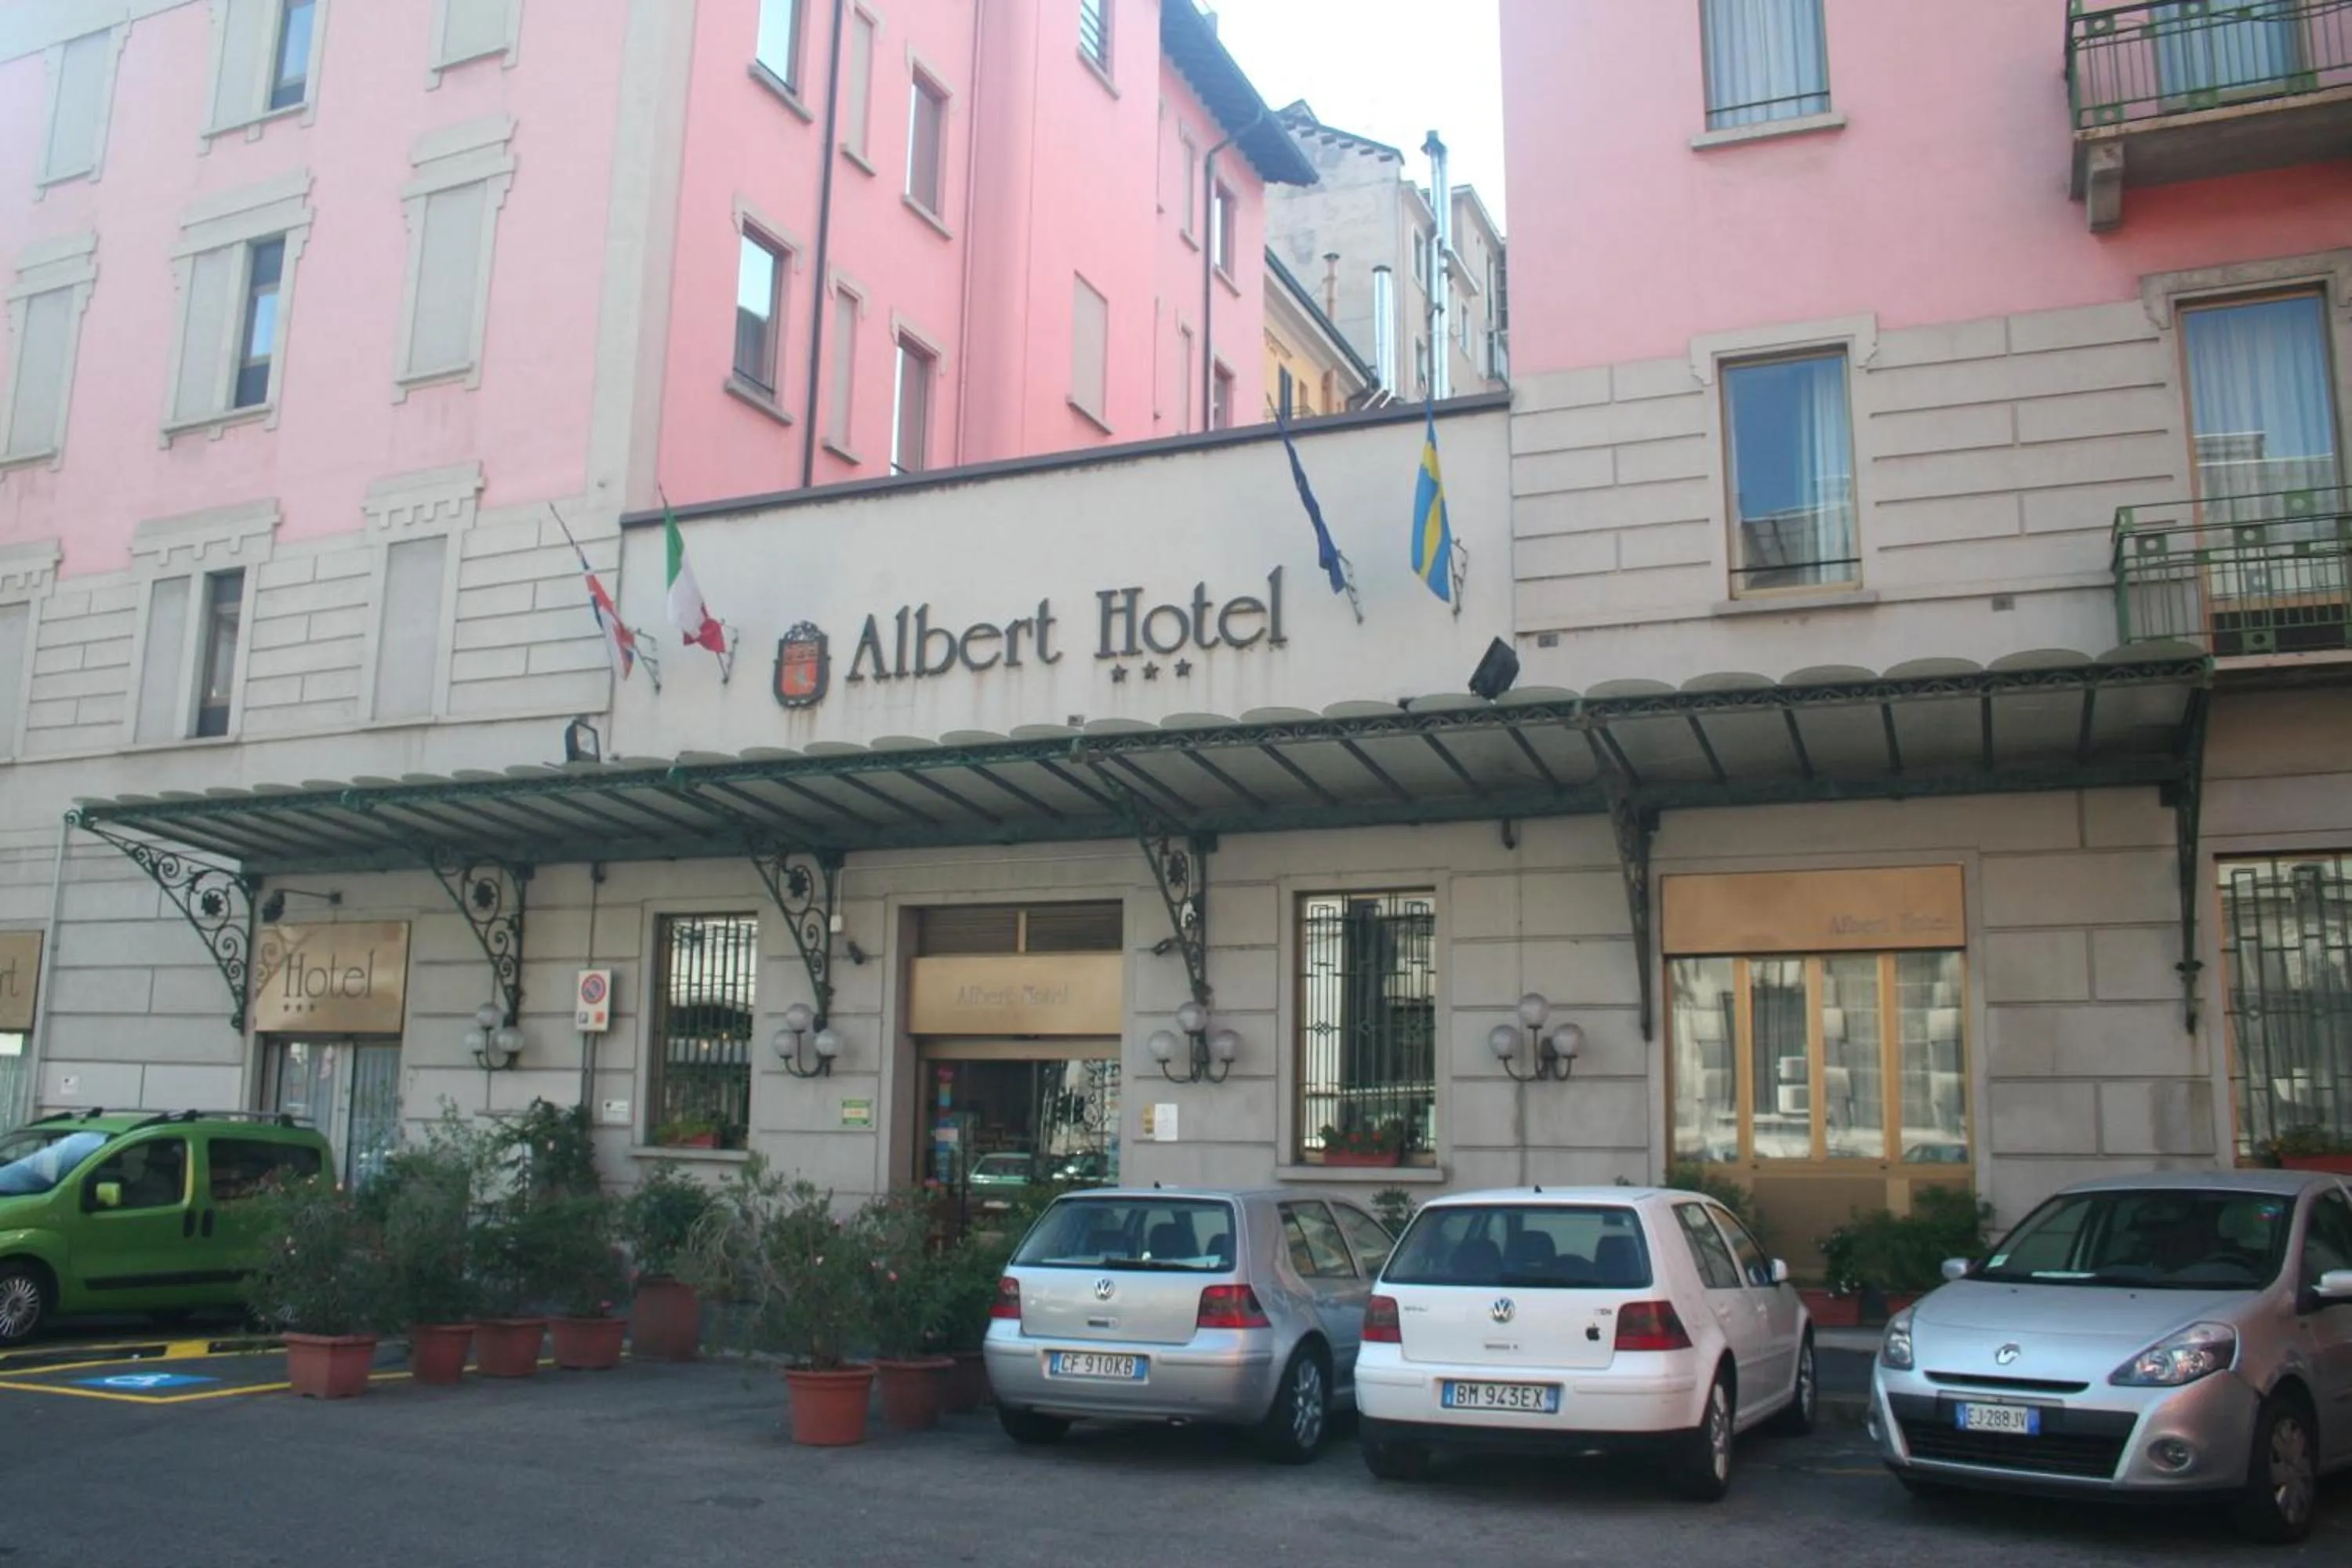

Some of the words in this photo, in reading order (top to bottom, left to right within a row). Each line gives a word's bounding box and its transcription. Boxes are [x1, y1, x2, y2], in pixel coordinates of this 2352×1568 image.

[846, 598, 1063, 683] Albert
[1094, 564, 1288, 659] Hotel
[283, 948, 375, 998] Hotel
[1062, 1354, 1081, 1373] CF
[1456, 1385, 1479, 1404] BM
[1485, 1385, 1543, 1408] 943EX
